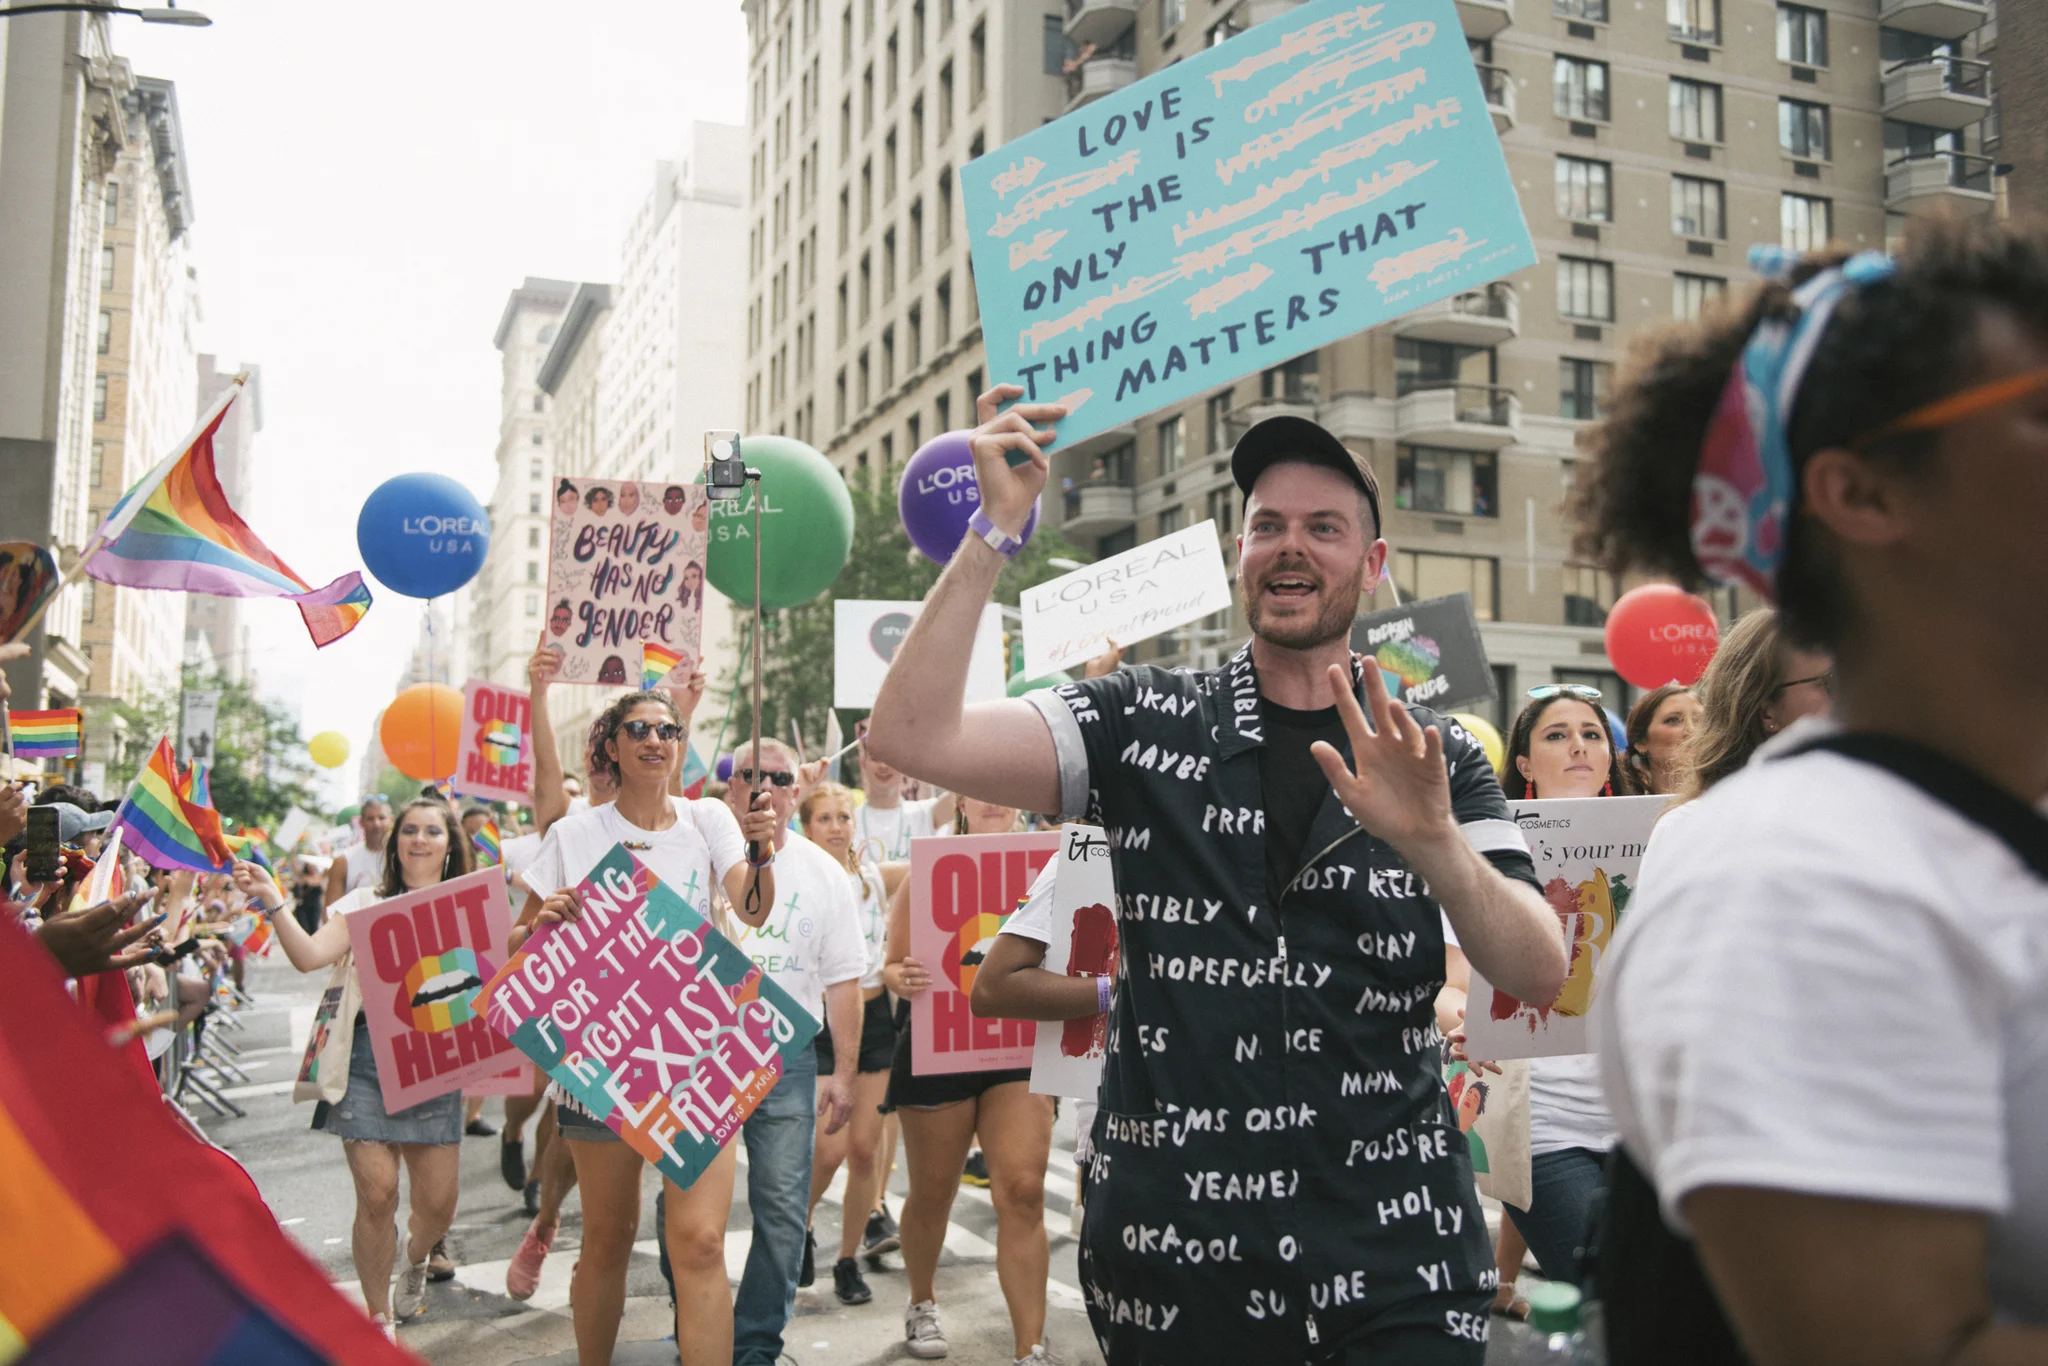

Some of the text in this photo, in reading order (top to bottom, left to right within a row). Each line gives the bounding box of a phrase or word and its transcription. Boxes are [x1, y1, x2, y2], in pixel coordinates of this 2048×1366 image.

[1078, 87, 1182, 157] LOVE
[1176, 116, 1215, 159] IS
[1091, 175, 1182, 232] THE
[1023, 241, 1126, 311] ONLY
[1017, 311, 1157, 401] THING
[1300, 202, 1426, 275] THAT
[1115, 288, 1340, 402] MATTERS
[948, 487, 979, 505] US
[430, 539, 472, 553] USA
[573, 519, 679, 564] BEAUTY
[590, 557, 673, 604] HAS NO
[1080, 579, 1158, 614] USA
[473, 687, 531, 734] OUT
[1055, 684, 1100, 724] URE
[1133, 686, 1197, 718] KAY
[1405, 674, 1450, 703] PRIDE
[466, 751, 530, 793] HERE
[1068, 831, 1111, 862] it COS
[1520, 819, 1571, 830] COSMETICS
[1558, 845, 1614, 868] your
[738, 892, 800, 943] ut
[1115, 893, 1223, 925] OSSIBLY
[369, 884, 492, 983] OUT
[494, 867, 637, 1027] FIGHTING
[536, 900, 666, 1053] FOR THE
[565, 929, 703, 1087] RIGHT TO
[603, 954, 737, 1129] EXIST
